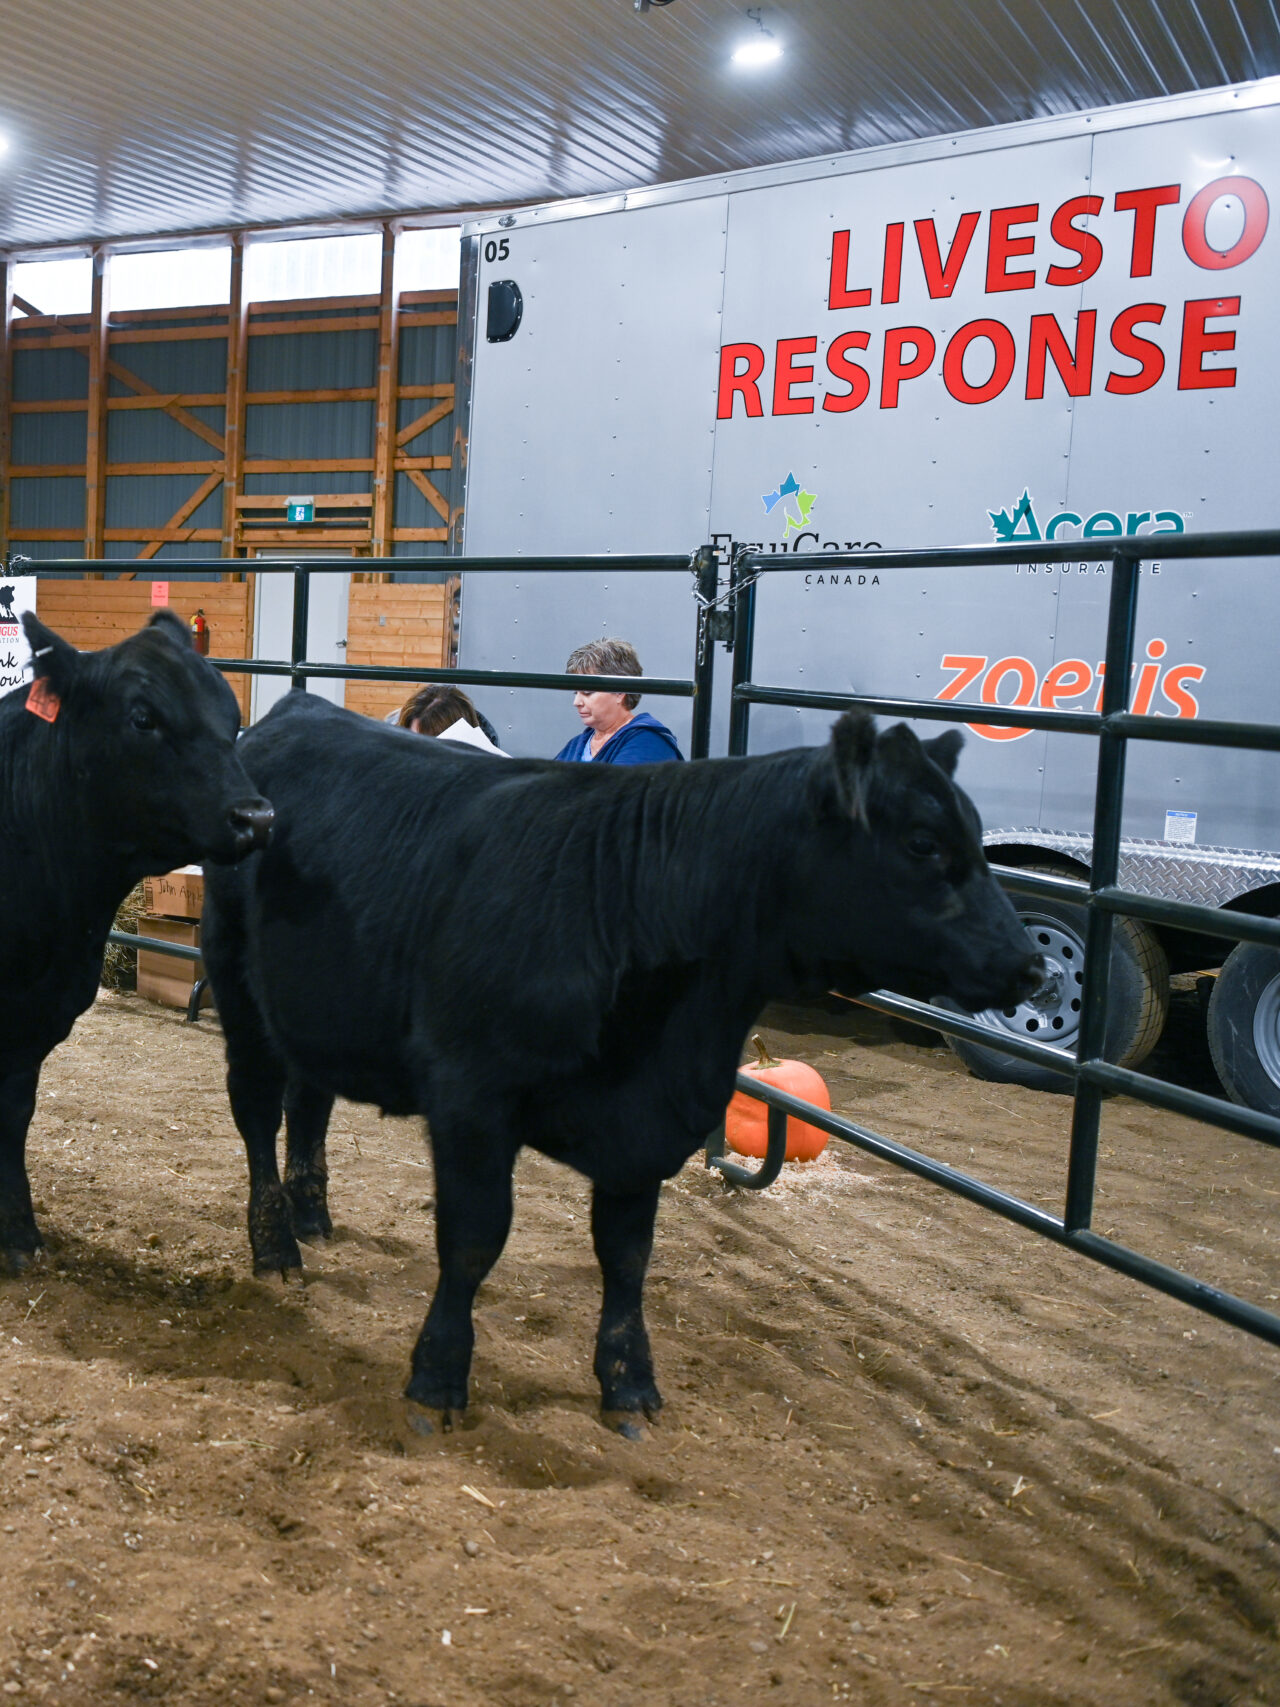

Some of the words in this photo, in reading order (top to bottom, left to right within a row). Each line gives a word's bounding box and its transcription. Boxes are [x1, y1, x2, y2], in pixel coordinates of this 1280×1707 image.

[485, 238, 510, 263] 05
[827, 175, 1270, 310] LIVESTO
[716, 295, 1242, 420] RESPONSE
[994, 496, 1185, 541] Acera
[804, 574, 880, 585] CANADA
[1016, 563, 1161, 574] INSURAE
